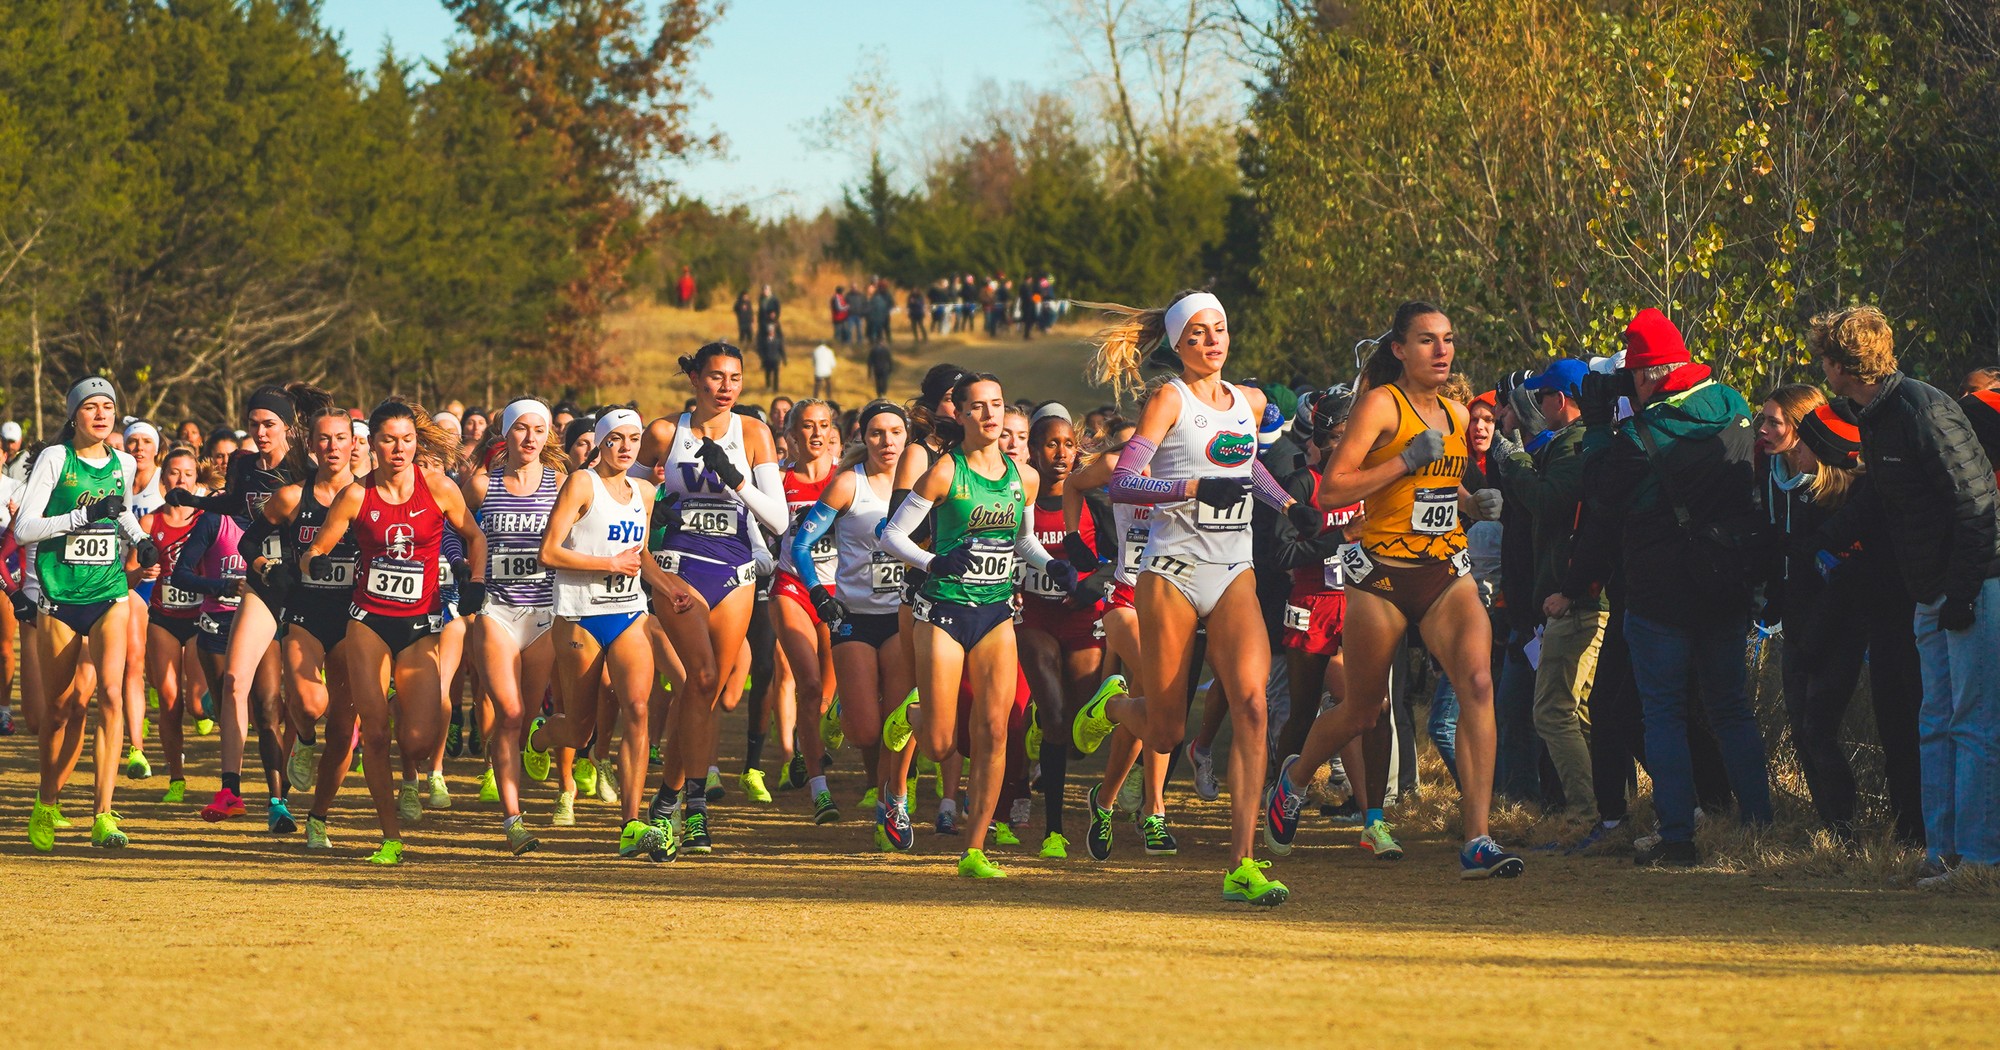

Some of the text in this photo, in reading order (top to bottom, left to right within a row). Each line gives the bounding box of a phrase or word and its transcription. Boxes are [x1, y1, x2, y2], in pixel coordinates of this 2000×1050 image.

[1121, 475, 1173, 493] GATORS
[689, 512, 729, 532] 466
[968, 501, 1017, 528] Irish
[1134, 508, 1150, 520] NC
[1421, 505, 1454, 527] 492
[607, 521, 644, 544] BYU
[74, 539, 108, 557] 303
[501, 558, 537, 575] 189
[970, 556, 1007, 576] 306
[1151, 556, 1188, 575] 177
[376, 573, 414, 595] 370
[604, 574, 636, 593] 137
[168, 588, 197, 603] 369
